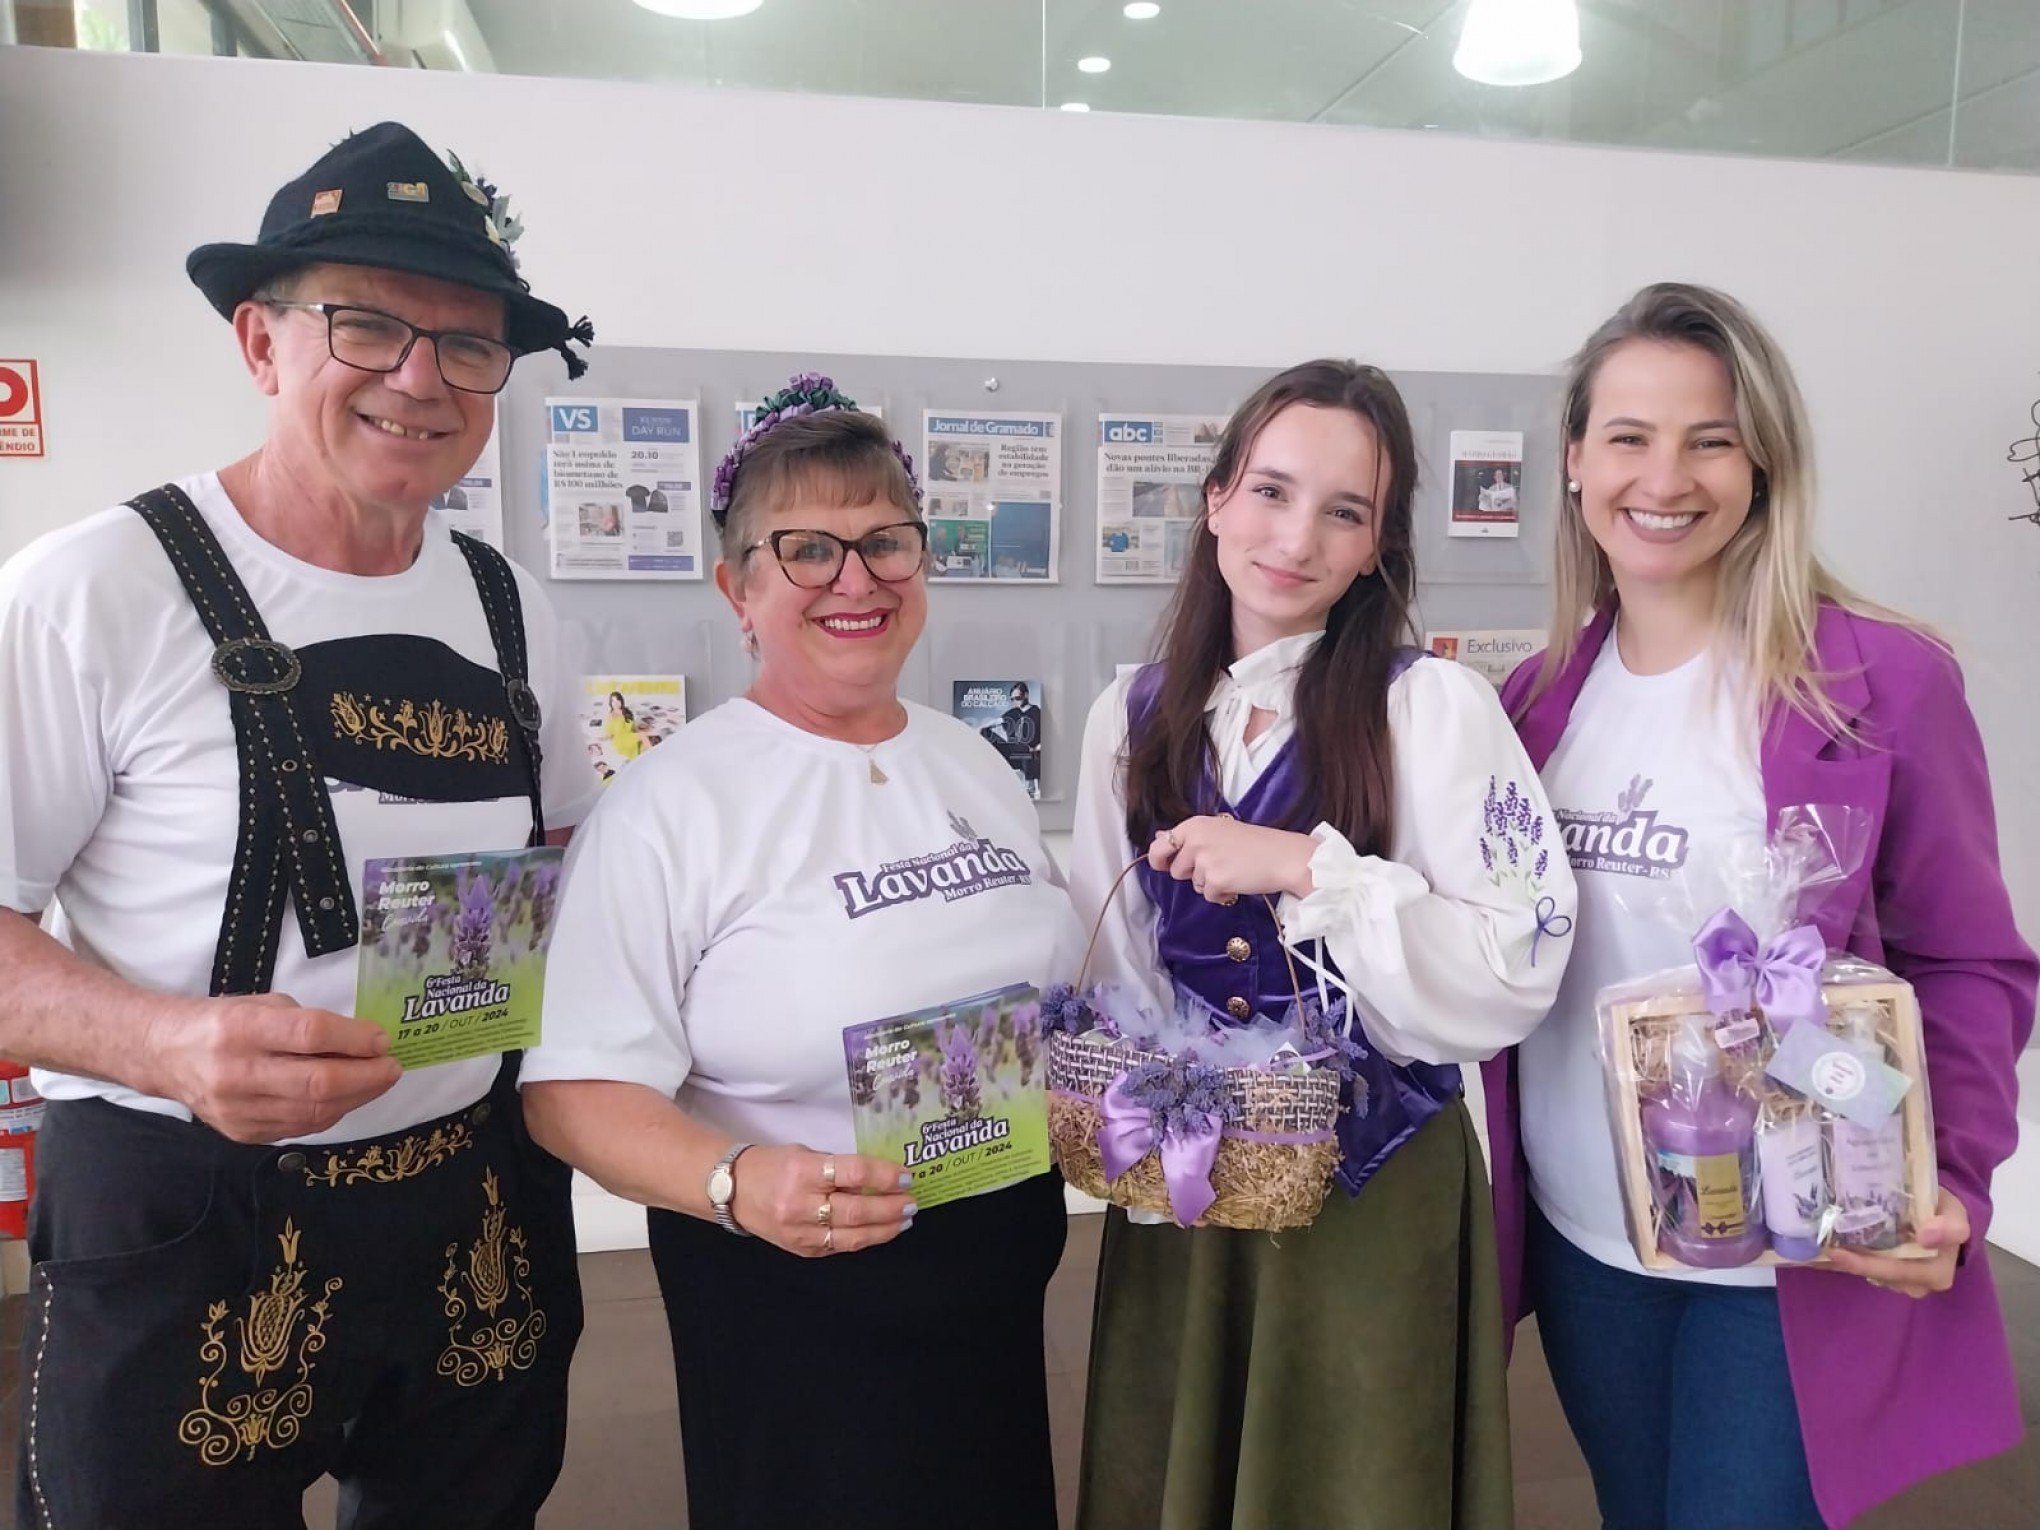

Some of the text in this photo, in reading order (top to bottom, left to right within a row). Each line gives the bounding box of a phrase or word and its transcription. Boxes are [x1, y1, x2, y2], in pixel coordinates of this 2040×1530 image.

[559, 408, 592, 430] VS
[933, 420, 1039, 435] Jornal de Gramado
[631, 426, 654, 436] DAY
[1109, 422, 1147, 441] abc
[631, 450, 659, 460] 20.10
[1104, 452, 1132, 461] Novas
[1134, 454, 1165, 463] pontes
[1467, 638, 1532, 654] Exclusivo
[1560, 817, 1683, 863] anda
[911, 848, 958, 867] Nacional
[1568, 856, 1595, 869] orro
[379, 880, 431, 896] Morro
[843, 844, 1026, 913] Lavanda
[944, 882, 982, 901] Morro
[378, 895, 436, 911] Reuter
[427, 981, 487, 999] Nacional da
[437, 975, 461, 986] Festa
[404, 982, 509, 1021] Lavanda
[398, 1029, 412, 1040] 17
[423, 1023, 440, 1035] 20
[449, 1016, 475, 1029] OUT
[482, 1008, 509, 1022] 2024
[865, 1039, 910, 1060] Morro
[866, 1051, 918, 1074] Reuter
[924, 1119, 983, 1143] Nacional da
[905, 1120, 1008, 1167] Lavanda
[929, 1164, 943, 1176] 20
[953, 1153, 977, 1168] OUT
[985, 1141, 1013, 1157] 2024
